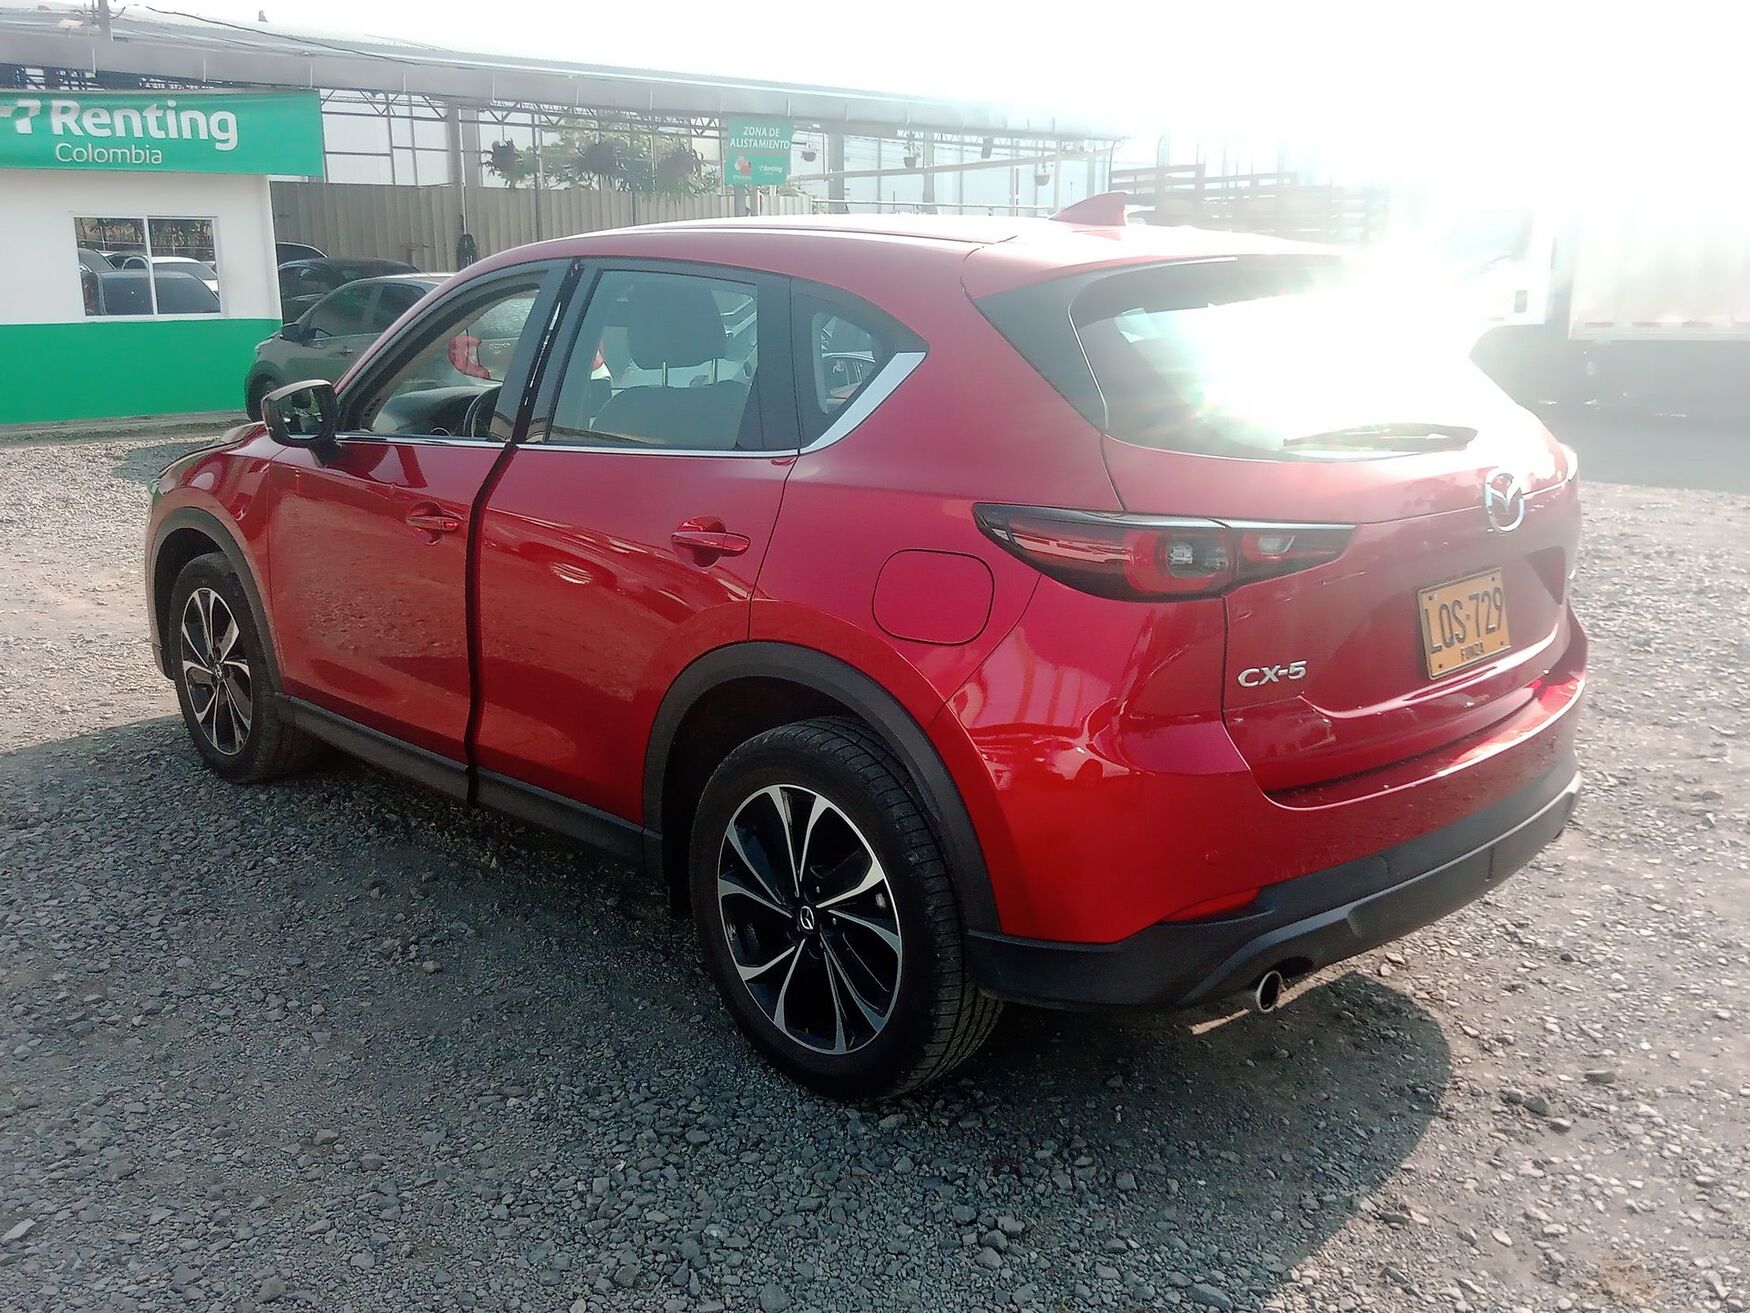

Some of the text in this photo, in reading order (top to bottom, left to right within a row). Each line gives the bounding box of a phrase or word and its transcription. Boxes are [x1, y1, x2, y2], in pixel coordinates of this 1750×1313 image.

[51, 99, 239, 151] Renting
[743, 126, 781, 138] ZONA DE
[55, 142, 163, 164] Colombia
[729, 137, 791, 150] ALISTAMIENTO
[1237, 660, 1308, 688] CX-5
